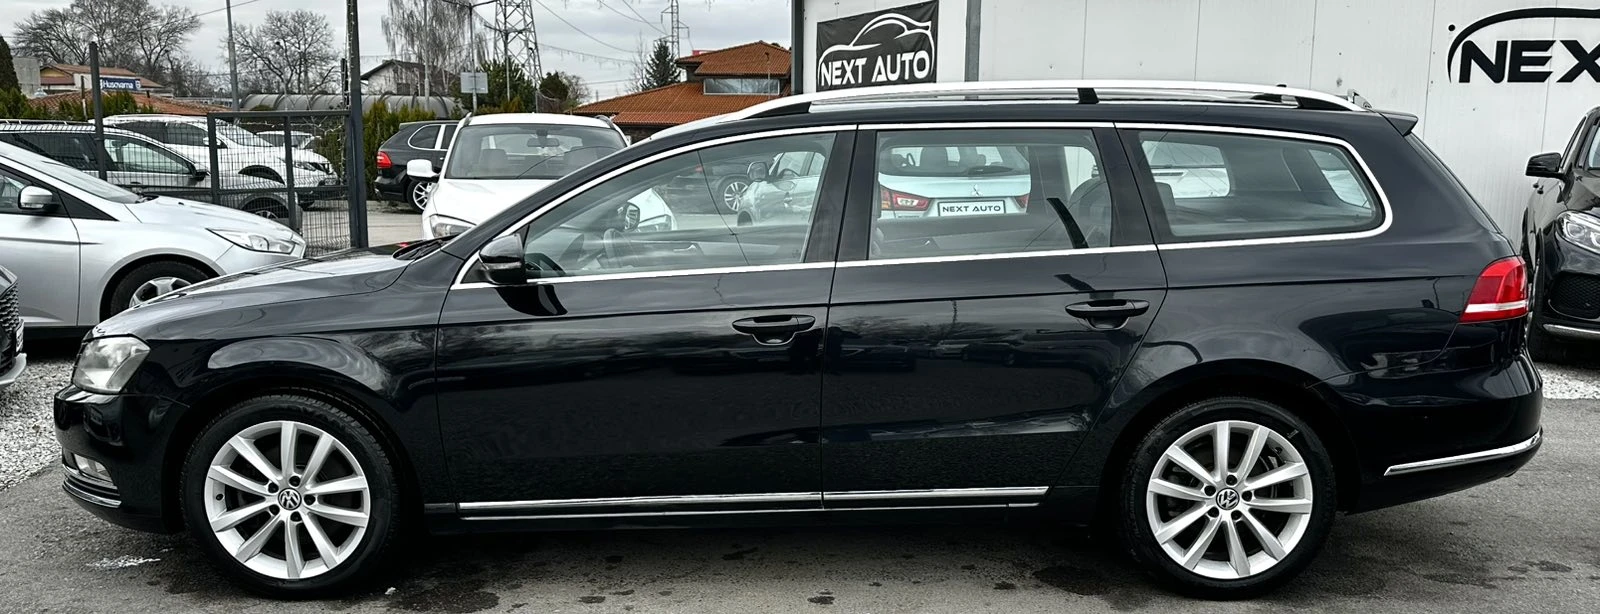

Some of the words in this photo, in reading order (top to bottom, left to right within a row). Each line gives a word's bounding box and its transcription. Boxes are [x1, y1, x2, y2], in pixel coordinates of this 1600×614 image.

[820, 57, 867, 87] NEXT
[871, 50, 930, 82] AUTO
[942, 205, 969, 213] NEXT
